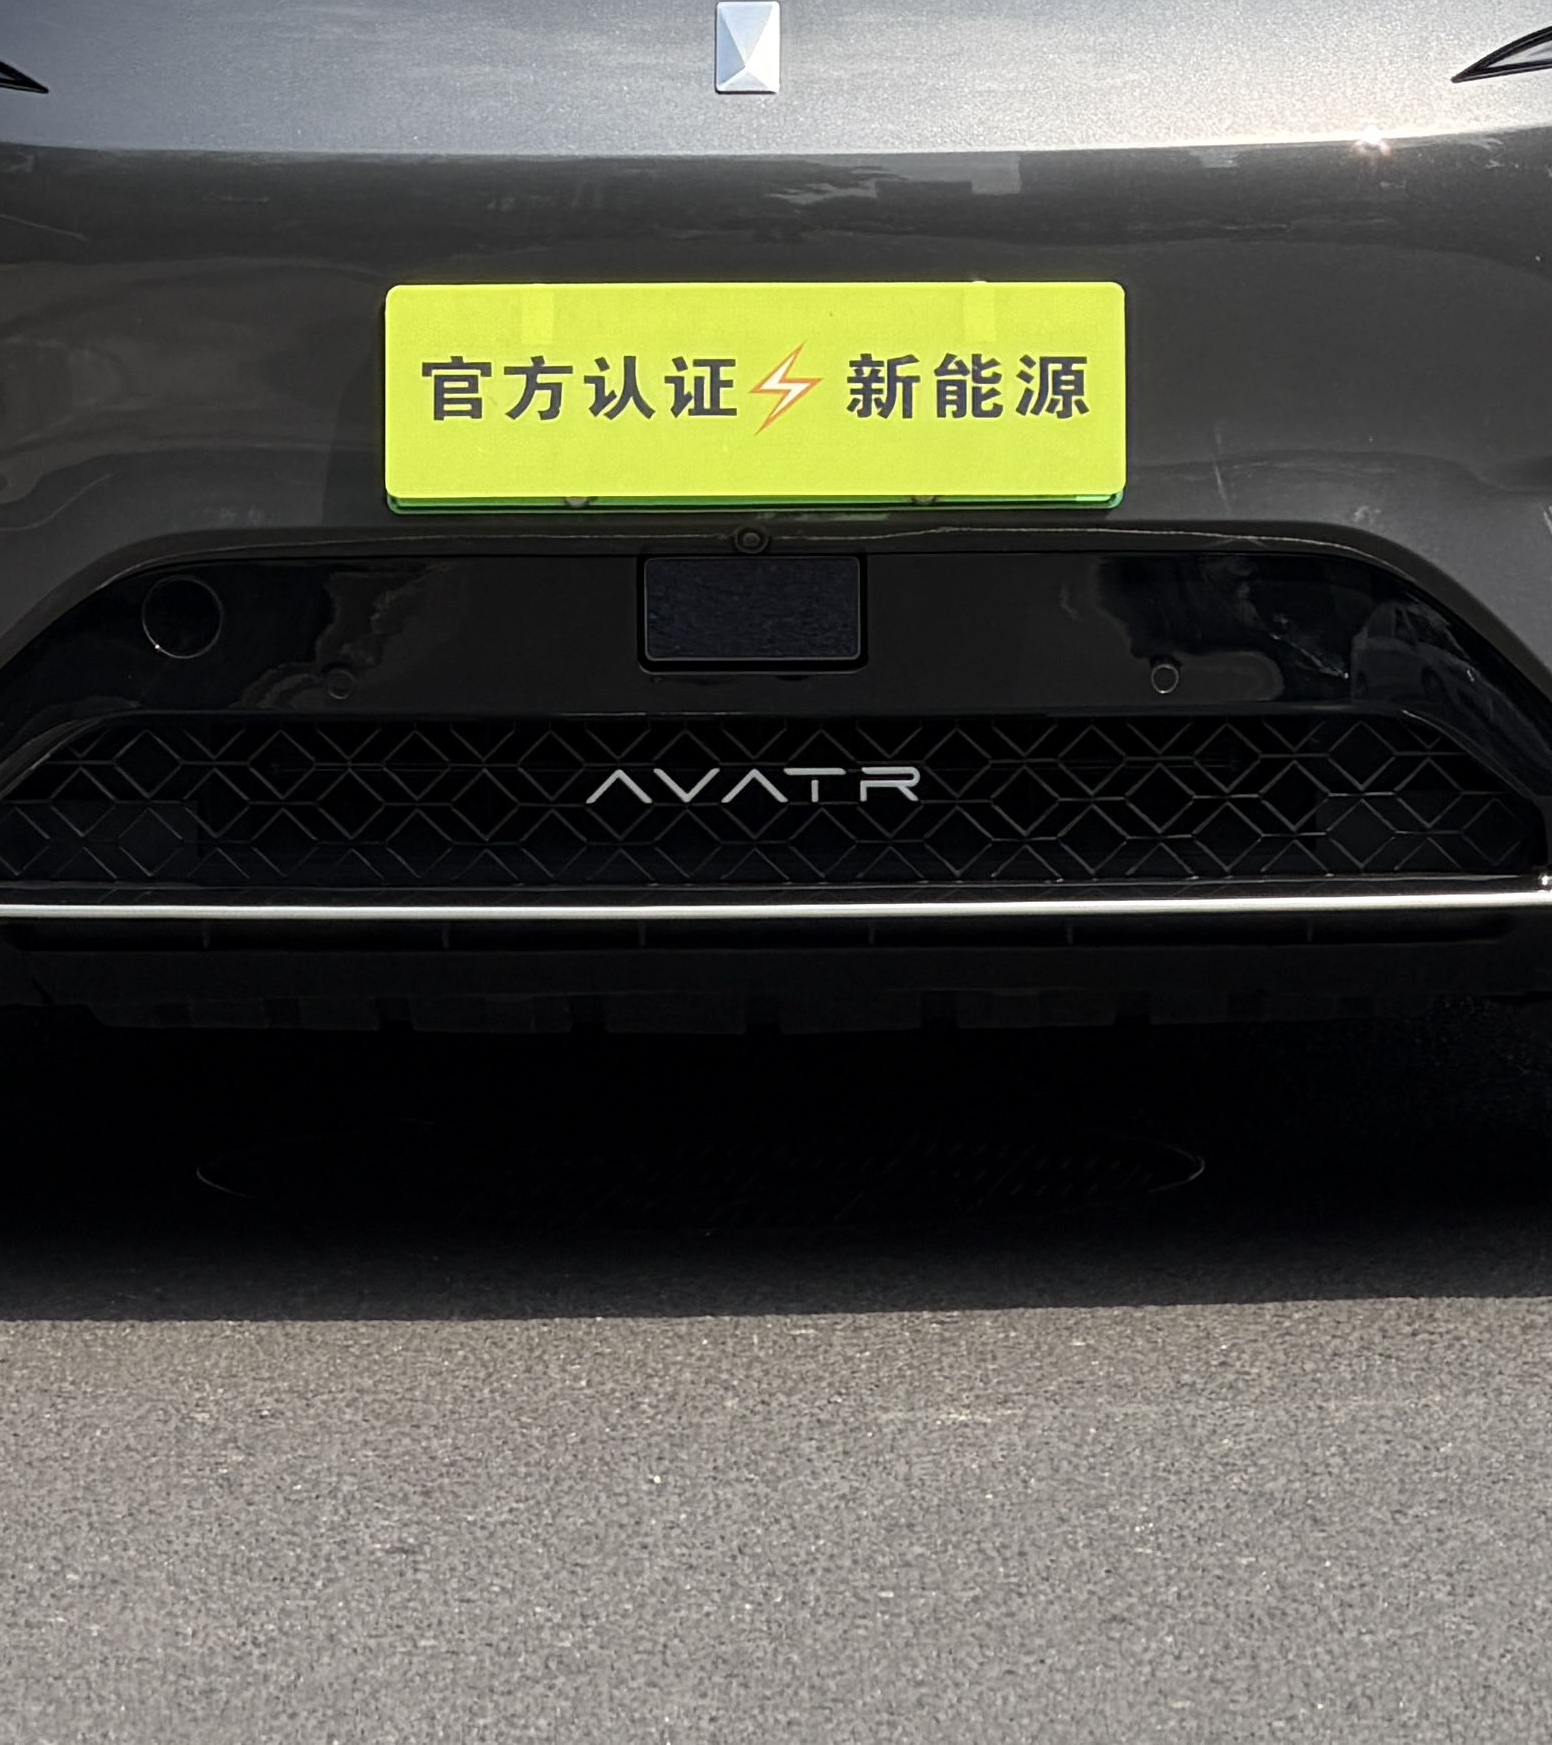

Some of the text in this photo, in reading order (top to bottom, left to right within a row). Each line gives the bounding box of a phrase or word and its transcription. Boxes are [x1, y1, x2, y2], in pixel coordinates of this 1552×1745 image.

[421, 352, 1090, 421] 官方认证 新能源
[586, 766, 921, 804] AVATR
